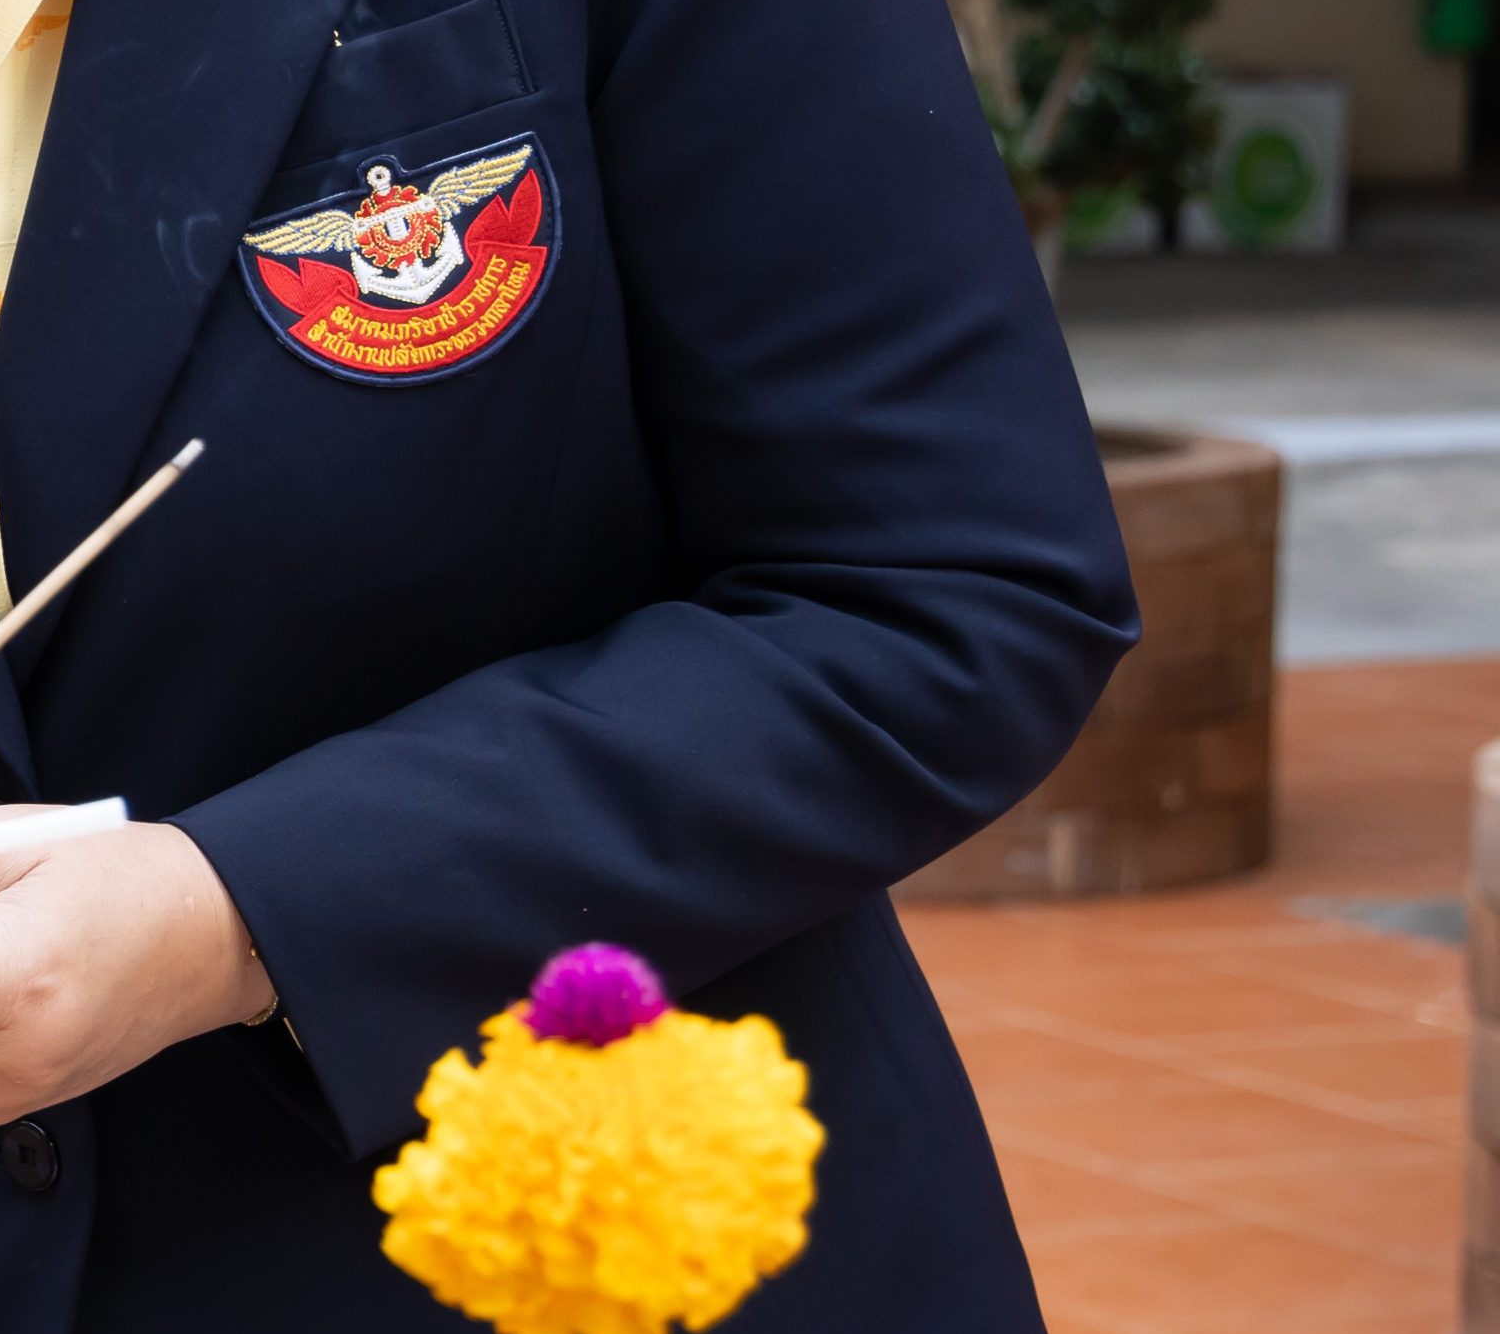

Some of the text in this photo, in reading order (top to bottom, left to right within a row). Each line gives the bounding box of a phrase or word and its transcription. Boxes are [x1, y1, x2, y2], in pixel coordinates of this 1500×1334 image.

[308, 260, 532, 366] สำนักงานปลัดกระทรวงกลาโหม
[330, 254, 507, 341] สมาคมภริยาข้าราชการ
